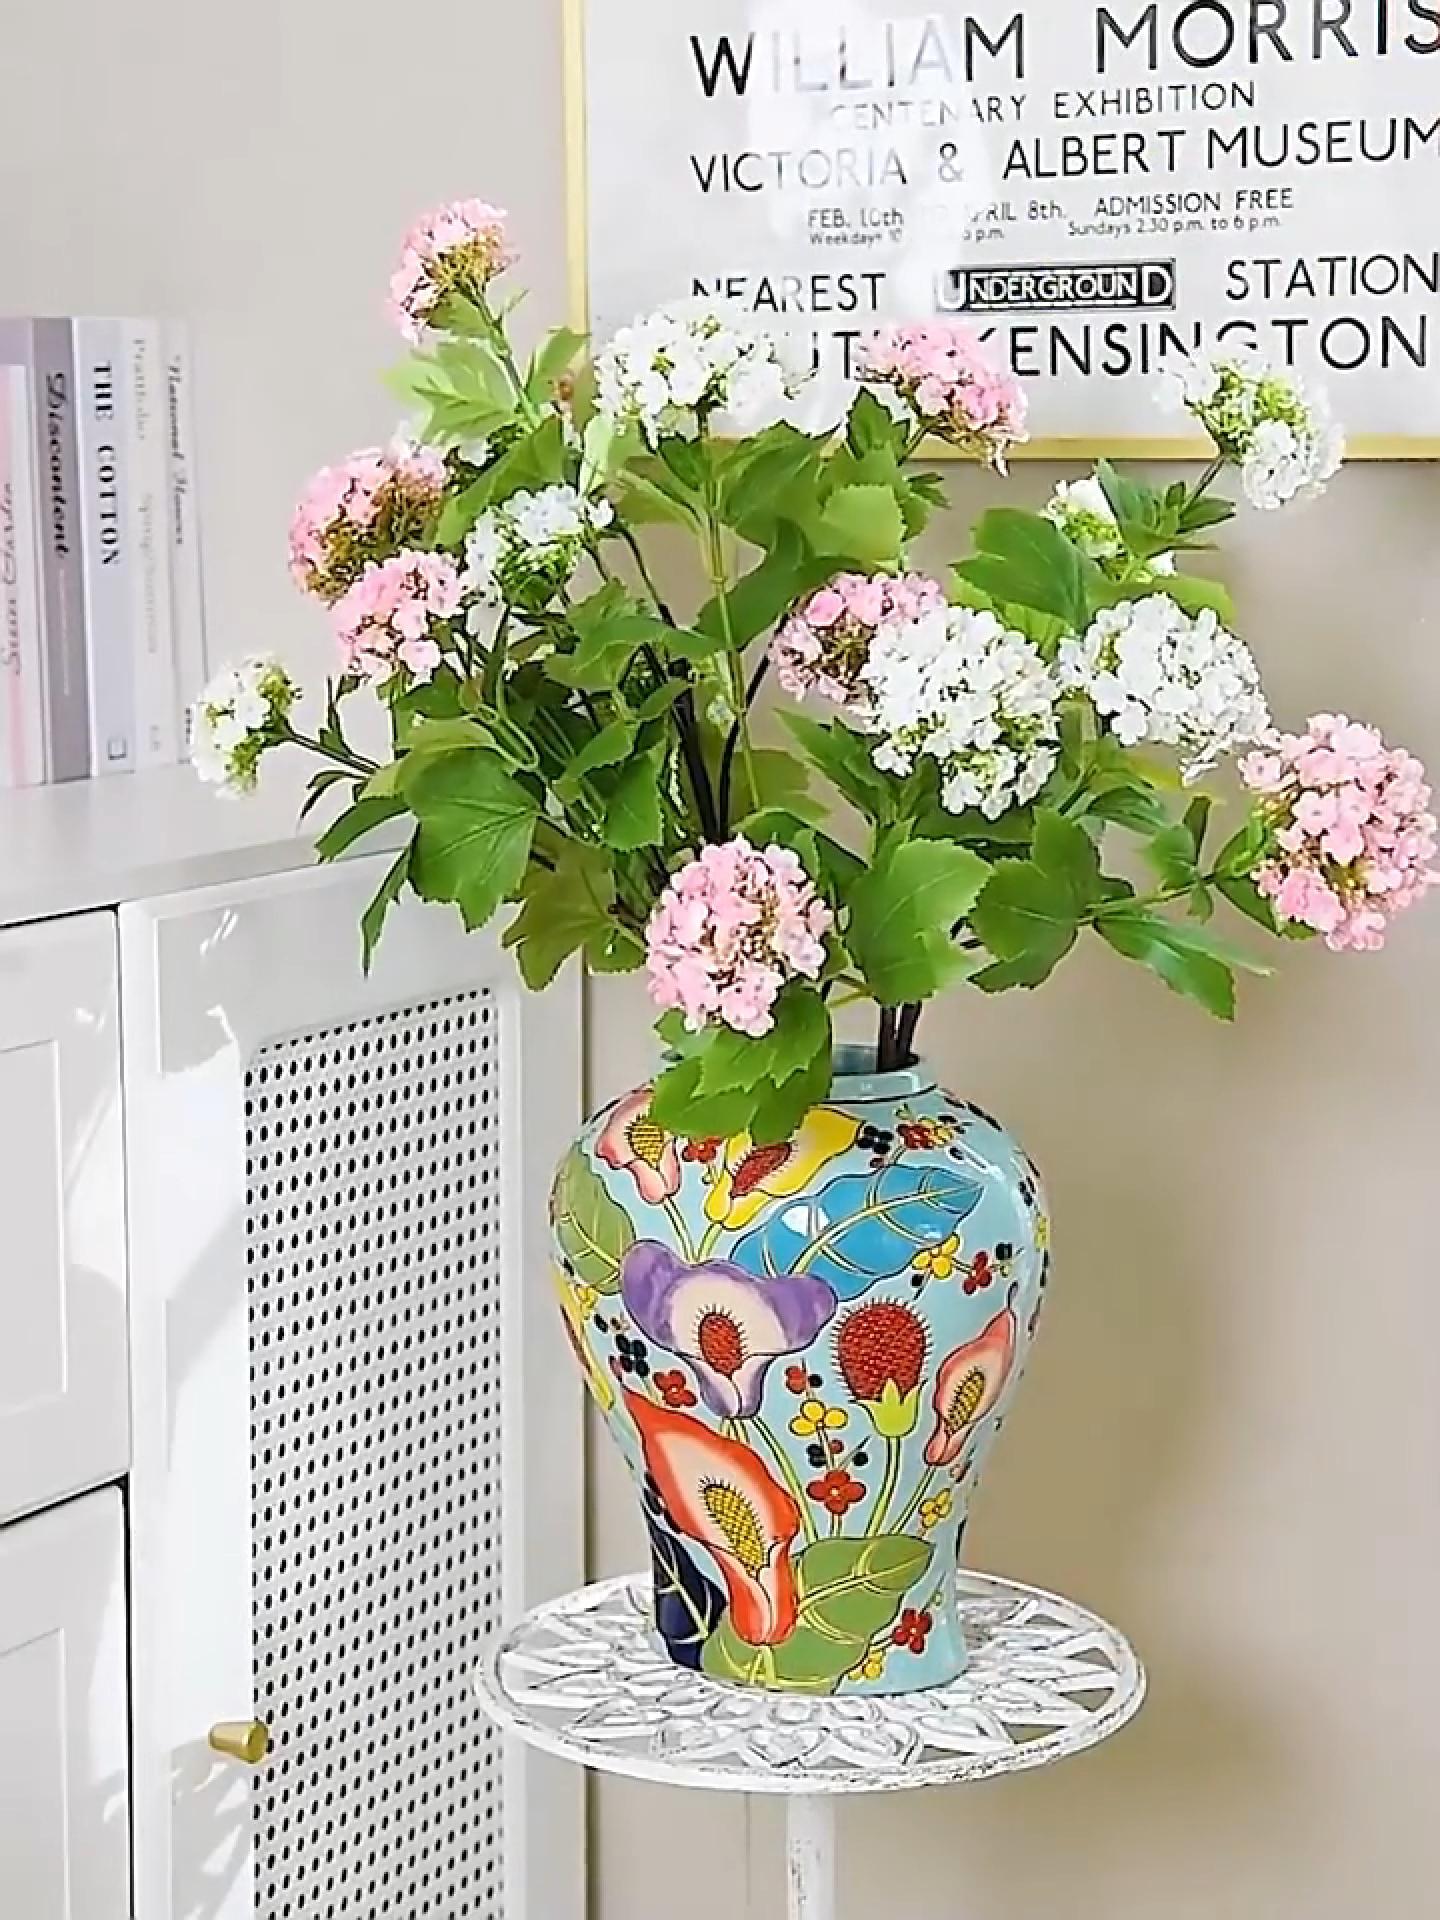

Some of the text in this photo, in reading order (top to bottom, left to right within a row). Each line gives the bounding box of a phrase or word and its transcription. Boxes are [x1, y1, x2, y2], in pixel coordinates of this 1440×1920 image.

[690, 0, 1440, 97] WILLIAM MORRIS
[1054, 80, 1255, 119] EXHIBITION
[690, 117, 1440, 193] VICTORIA & ALBERT MUSEUM
[860, 207, 904, 228] 10th
[1093, 192, 1221, 216] ADMISSION
[1235, 187, 1294, 211] FREE
[1067, 219, 1131, 239] Sundays
[1211, 216, 1229, 231] to
[691, 251, 1440, 313] NEAREST UNDERGROUND STATION
[976, 314, 1427, 377] ENSINGTON
[94, 360, 119, 565] THE COTTON
